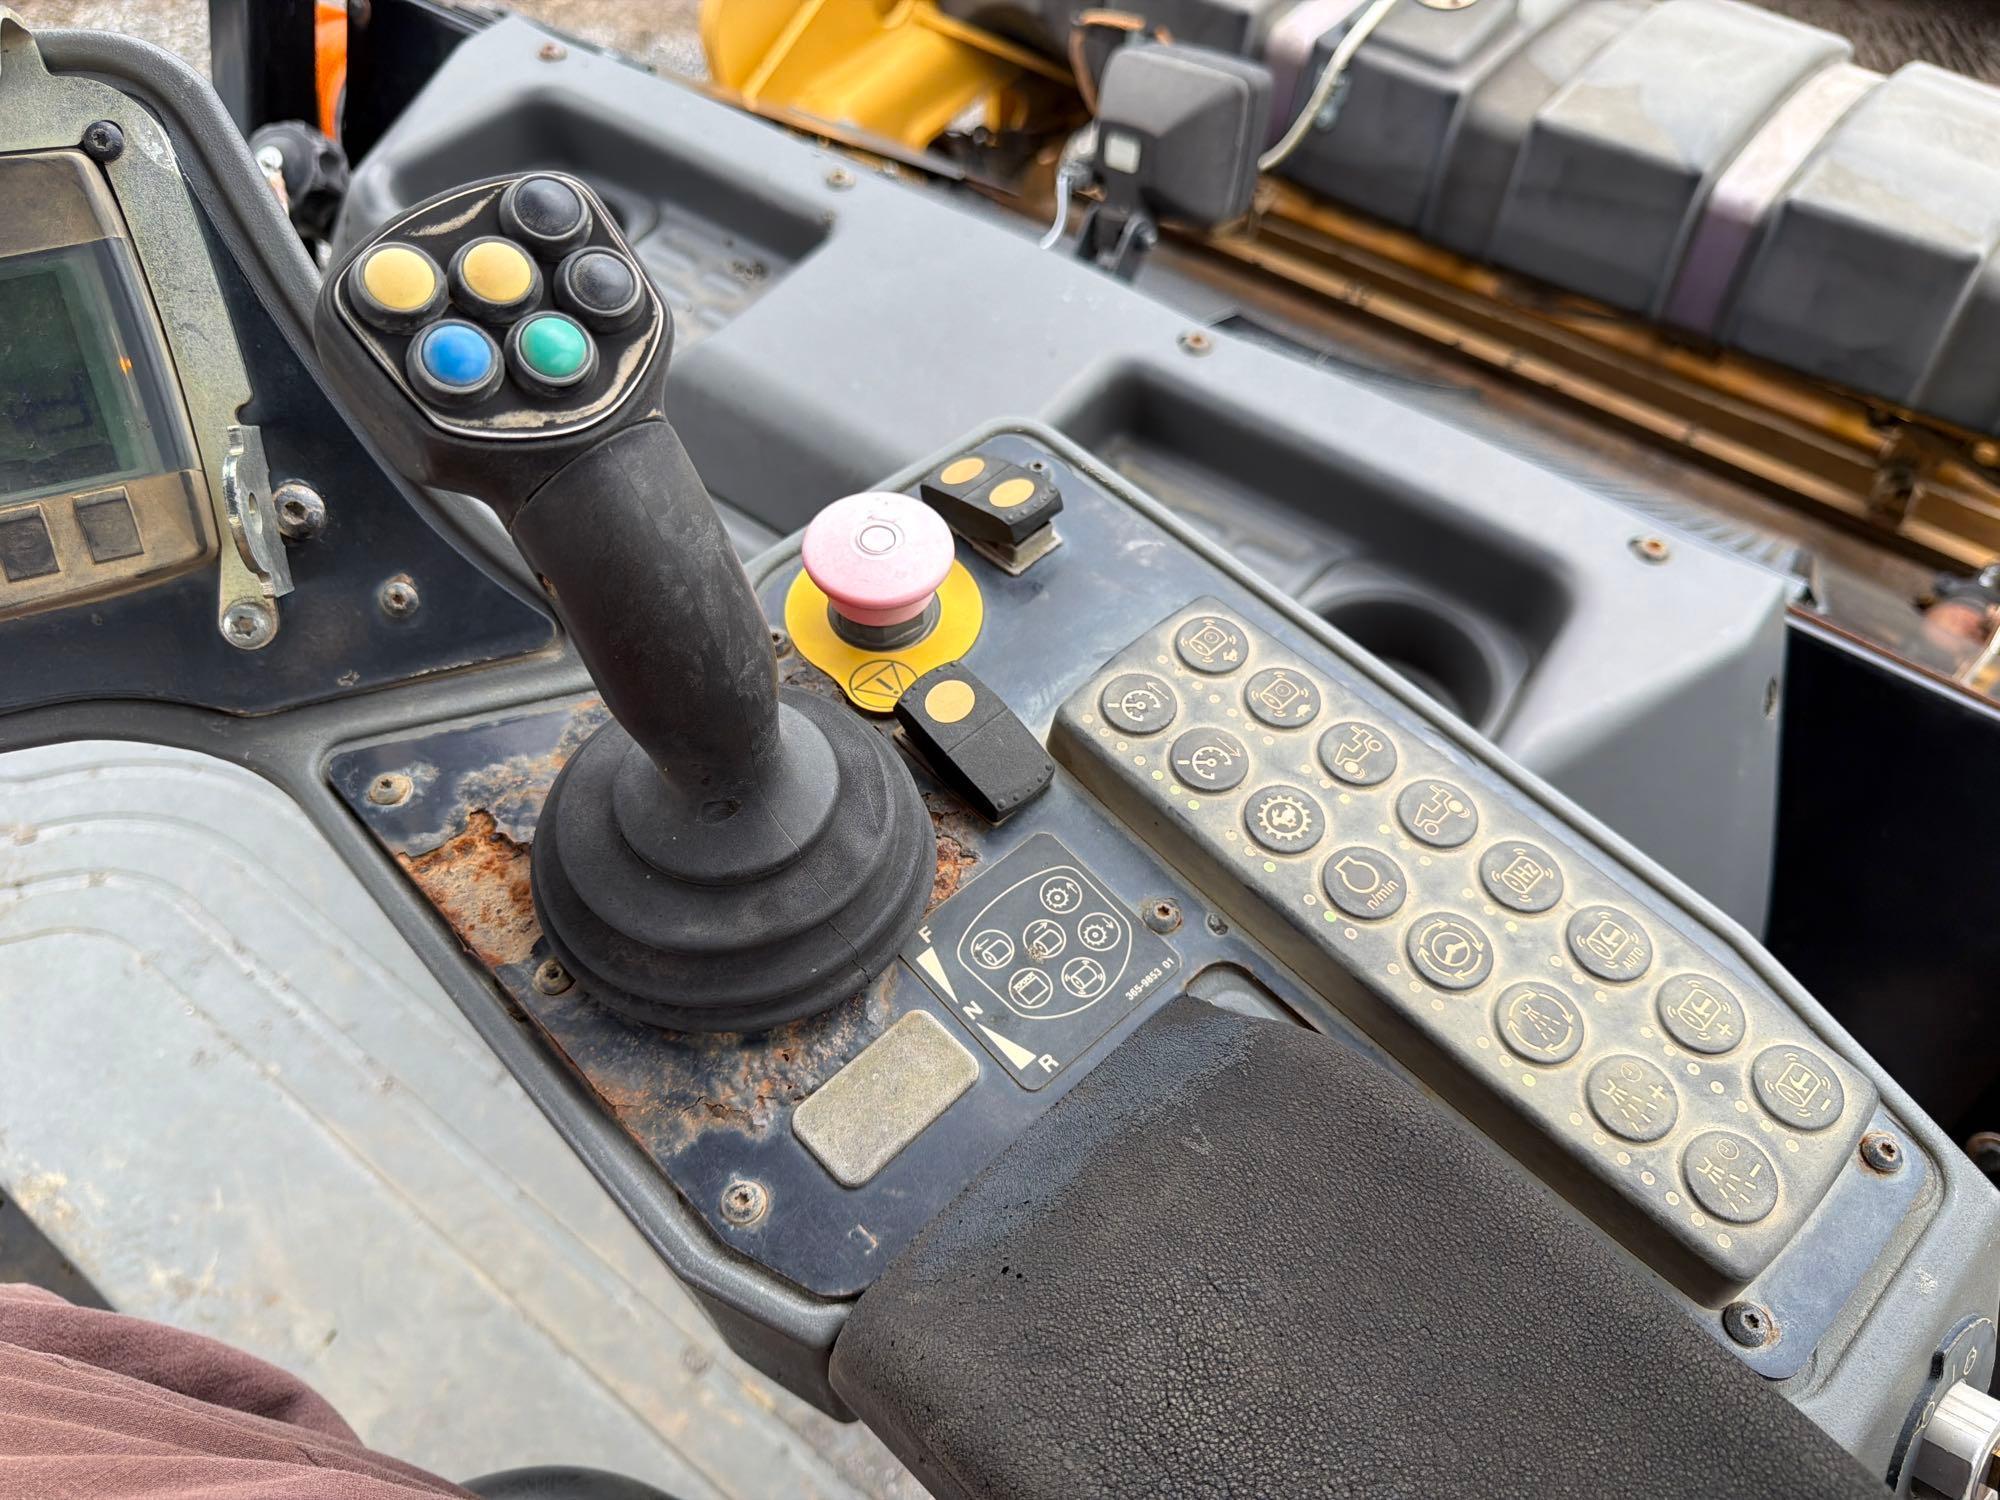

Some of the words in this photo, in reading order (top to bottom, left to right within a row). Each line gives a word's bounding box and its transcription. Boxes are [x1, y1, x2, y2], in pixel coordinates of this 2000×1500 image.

[1512, 862, 1540, 883] Hz
[1366, 880, 1400, 911] n/min
[918, 925, 932, 944] F
[1622, 947, 1644, 970] AUTO
[1125, 968, 1162, 1001] 365-9853
[1162, 957, 1175, 969] 01
[962, 1000, 983, 1020] N
[1037, 1053, 1060, 1073] R
